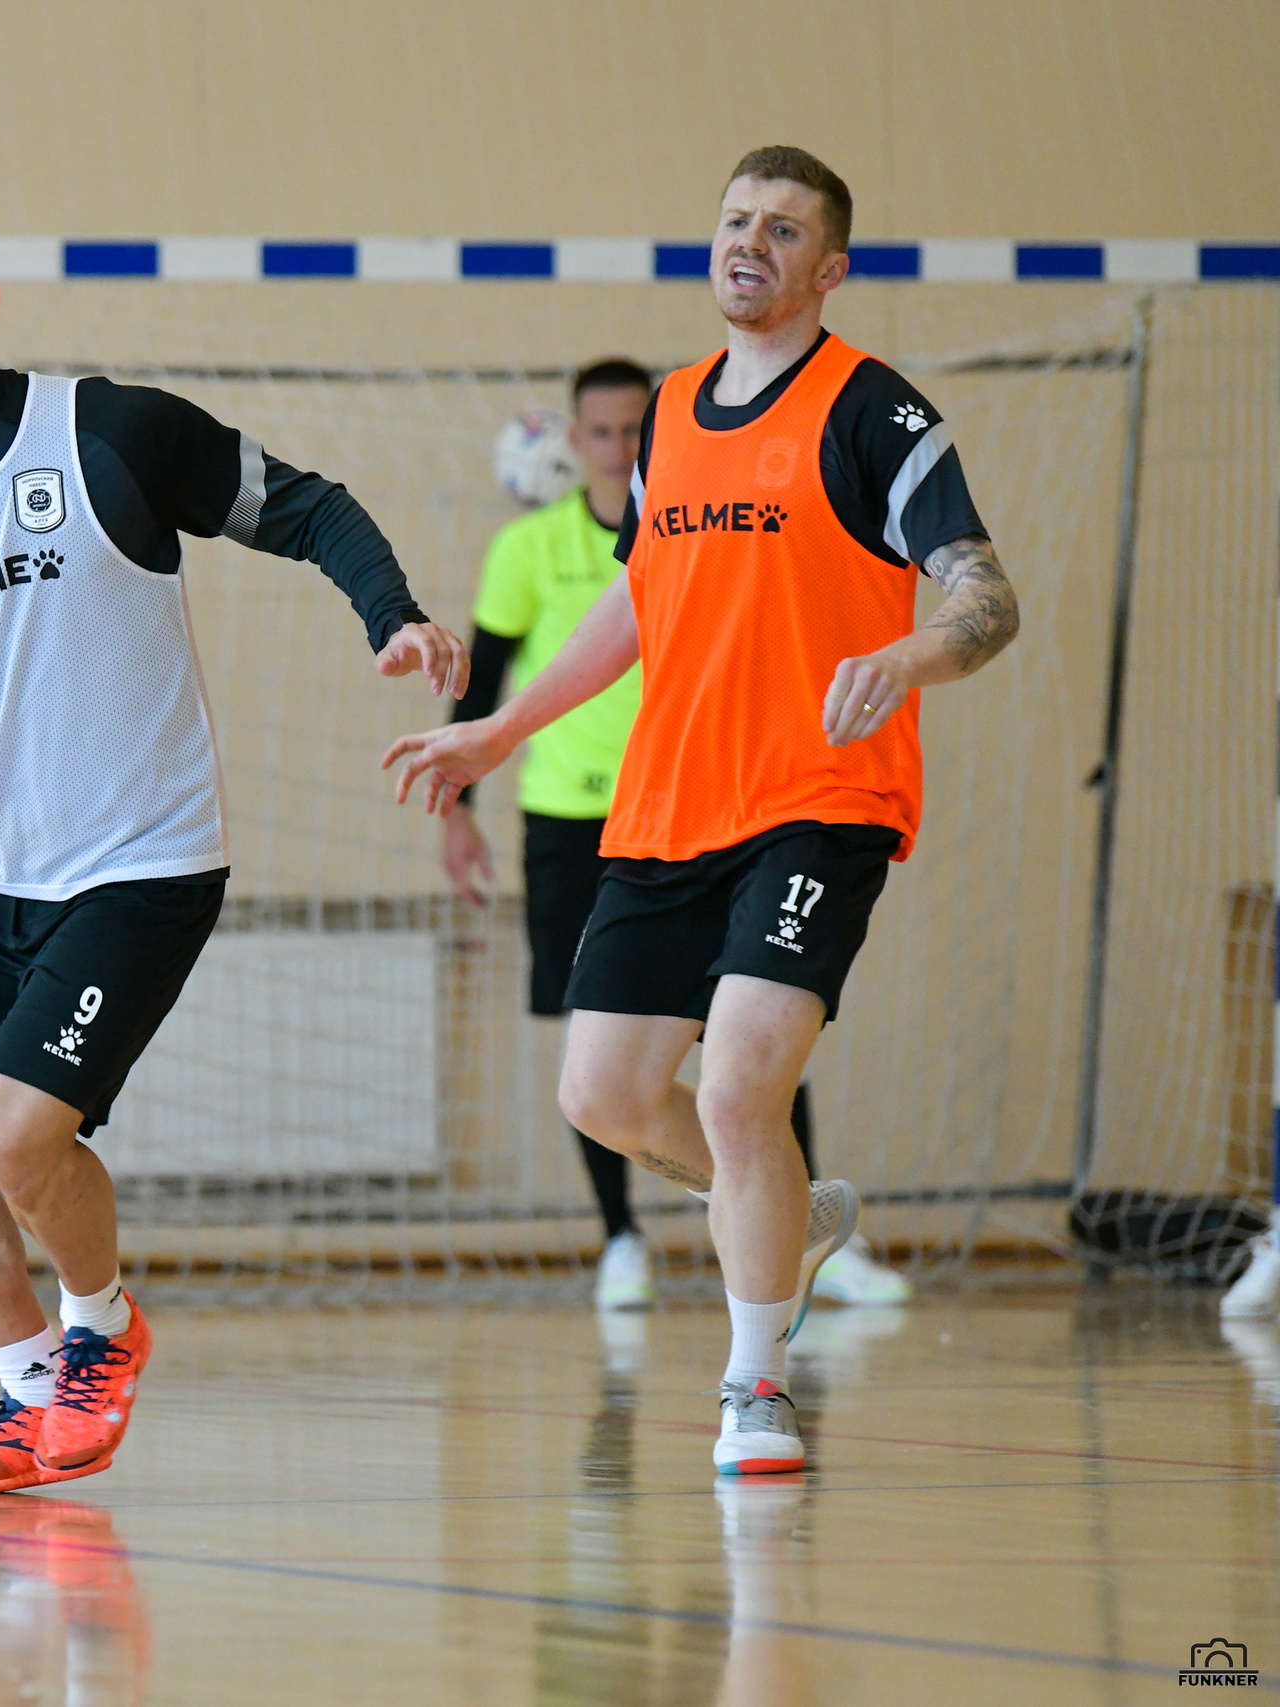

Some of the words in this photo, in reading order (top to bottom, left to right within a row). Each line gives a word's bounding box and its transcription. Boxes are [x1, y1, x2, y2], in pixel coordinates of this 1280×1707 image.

[652, 503, 754, 540] KELME
[780, 873, 825, 918] 17
[764, 933, 805, 954] KELME
[73, 985, 103, 1026] 9
[42, 1041, 83, 1067] KELME
[20, 1367, 55, 1380] adidas
